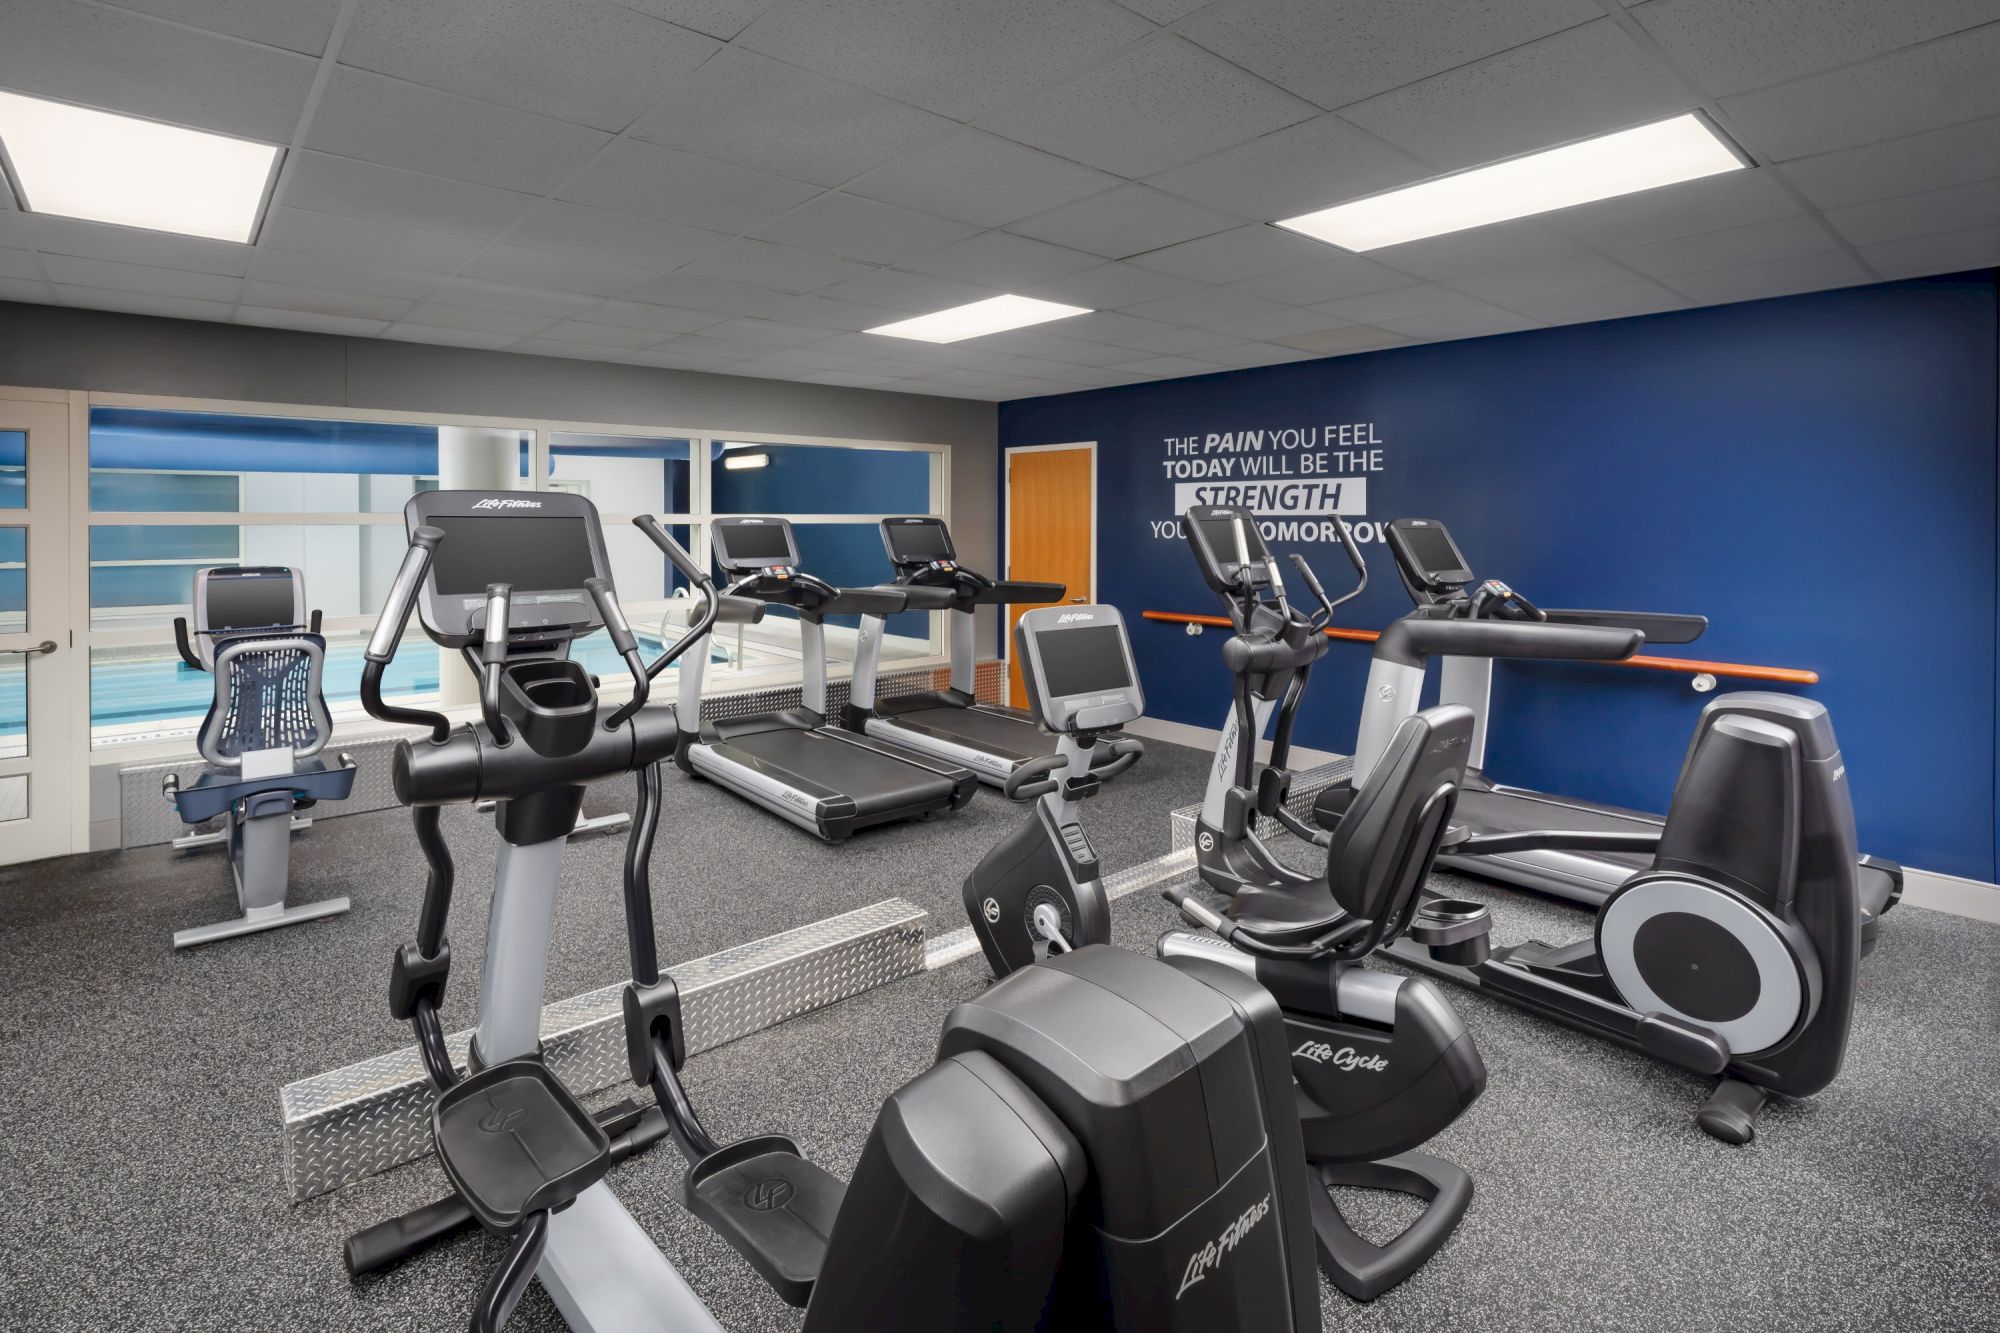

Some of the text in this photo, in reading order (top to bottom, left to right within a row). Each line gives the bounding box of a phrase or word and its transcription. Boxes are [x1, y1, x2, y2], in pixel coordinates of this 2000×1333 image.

[1164, 423, 1383, 456] THE PAIN YOU FEEL
[1163, 449, 1384, 479] TODAY WILL BE THE
[1194, 482, 1342, 511] STRENGTH
[1291, 1040, 1388, 1072] Life Cycle
[1175, 1192, 1271, 1301] Life Fitness
